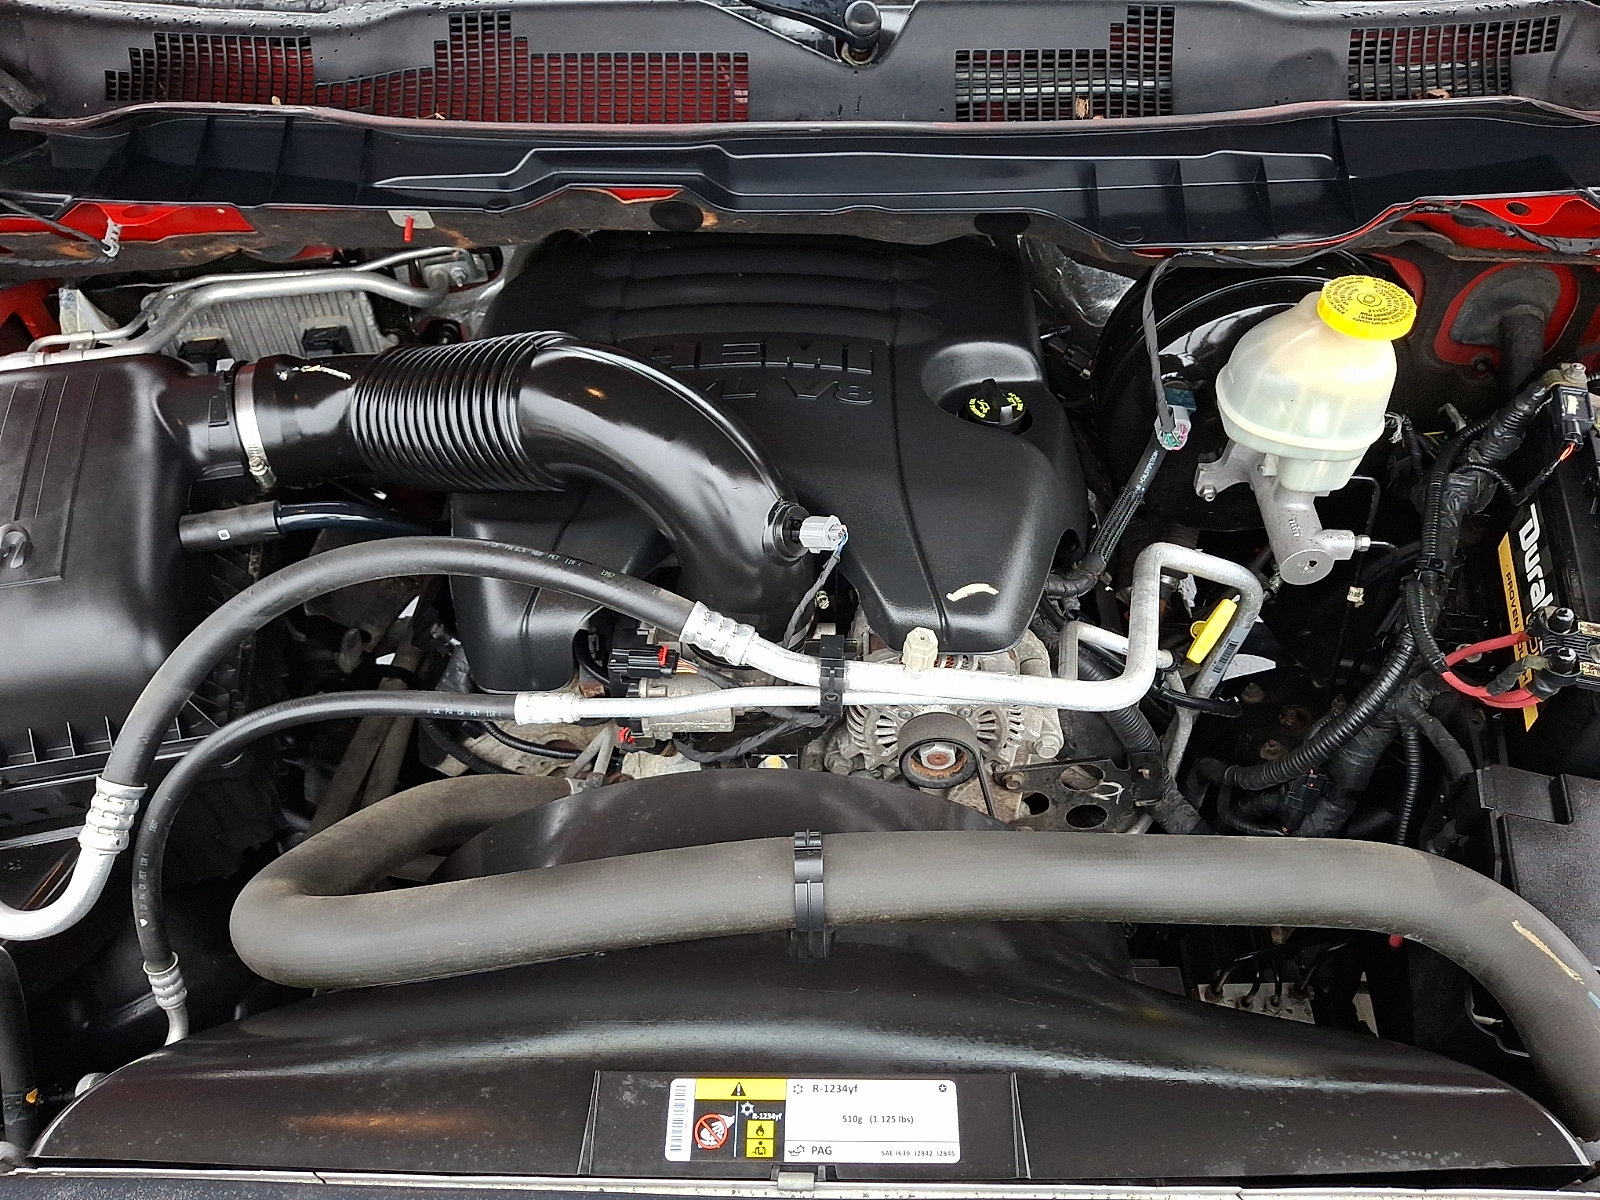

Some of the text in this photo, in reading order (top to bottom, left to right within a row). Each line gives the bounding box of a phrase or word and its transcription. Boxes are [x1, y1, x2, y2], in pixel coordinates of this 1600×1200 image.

[1519, 503, 1554, 613] Dural
[1506, 571, 1520, 629] PROVEN
[812, 1084, 858, 1095] R-1234yf
[752, 1112, 783, 1121] R-1234yf
[842, 1115, 863, 1124] 510g
[898, 1115, 914, 1124] lbs)
[811, 1145, 832, 1156] PAG
